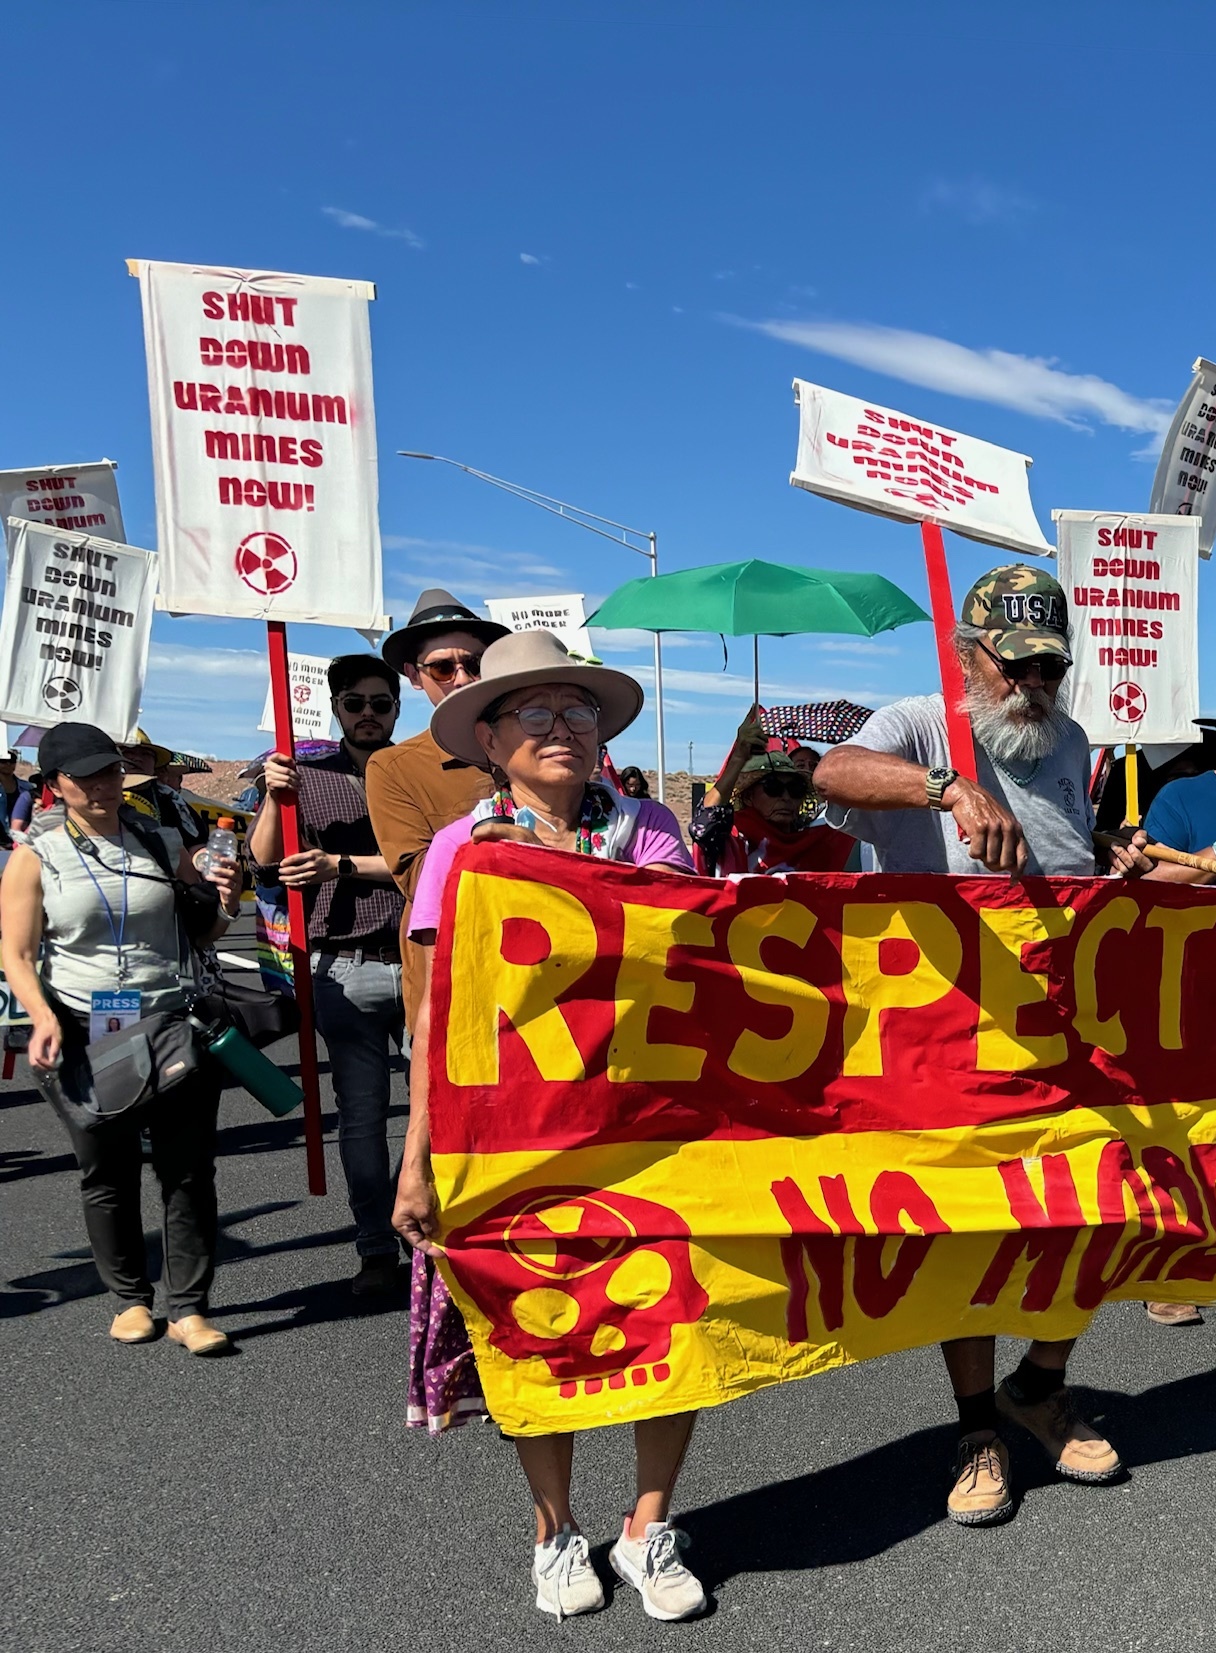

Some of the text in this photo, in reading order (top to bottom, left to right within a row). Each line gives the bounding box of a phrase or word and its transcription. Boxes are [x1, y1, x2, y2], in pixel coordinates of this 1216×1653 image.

[202, 291, 298, 327] SHUT
[199, 336, 311, 375] DOWN
[173, 380, 348, 425] URANIUM
[864, 409, 957, 447] SHUT
[204, 430, 324, 468] MINES
[25, 476, 77, 492] SHUT
[218, 476, 315, 512] NOW!
[26, 494, 85, 513] DOWN
[30, 512, 107, 531] NIUM
[1097, 527, 1158, 550] SHUT
[53, 541, 119, 572] SHUT
[1092, 557, 1160, 580] DOWN
[44, 565, 117, 598] DOWN
[21, 586, 135, 628] URANIUM
[1001, 593, 1063, 628] USA
[1073, 587, 1181, 611] URANIUM
[511, 608, 571, 622] NO MORE
[1090, 617, 1164, 640] MINES
[35, 616, 113, 649] MINES
[39, 642, 103, 672] NOW!
[1098, 647, 1158, 668] NOW!
[291, 674, 324, 686] ANCER
[92, 997, 140, 1009] PRESS
[770, 1170, 953, 1347] NO
